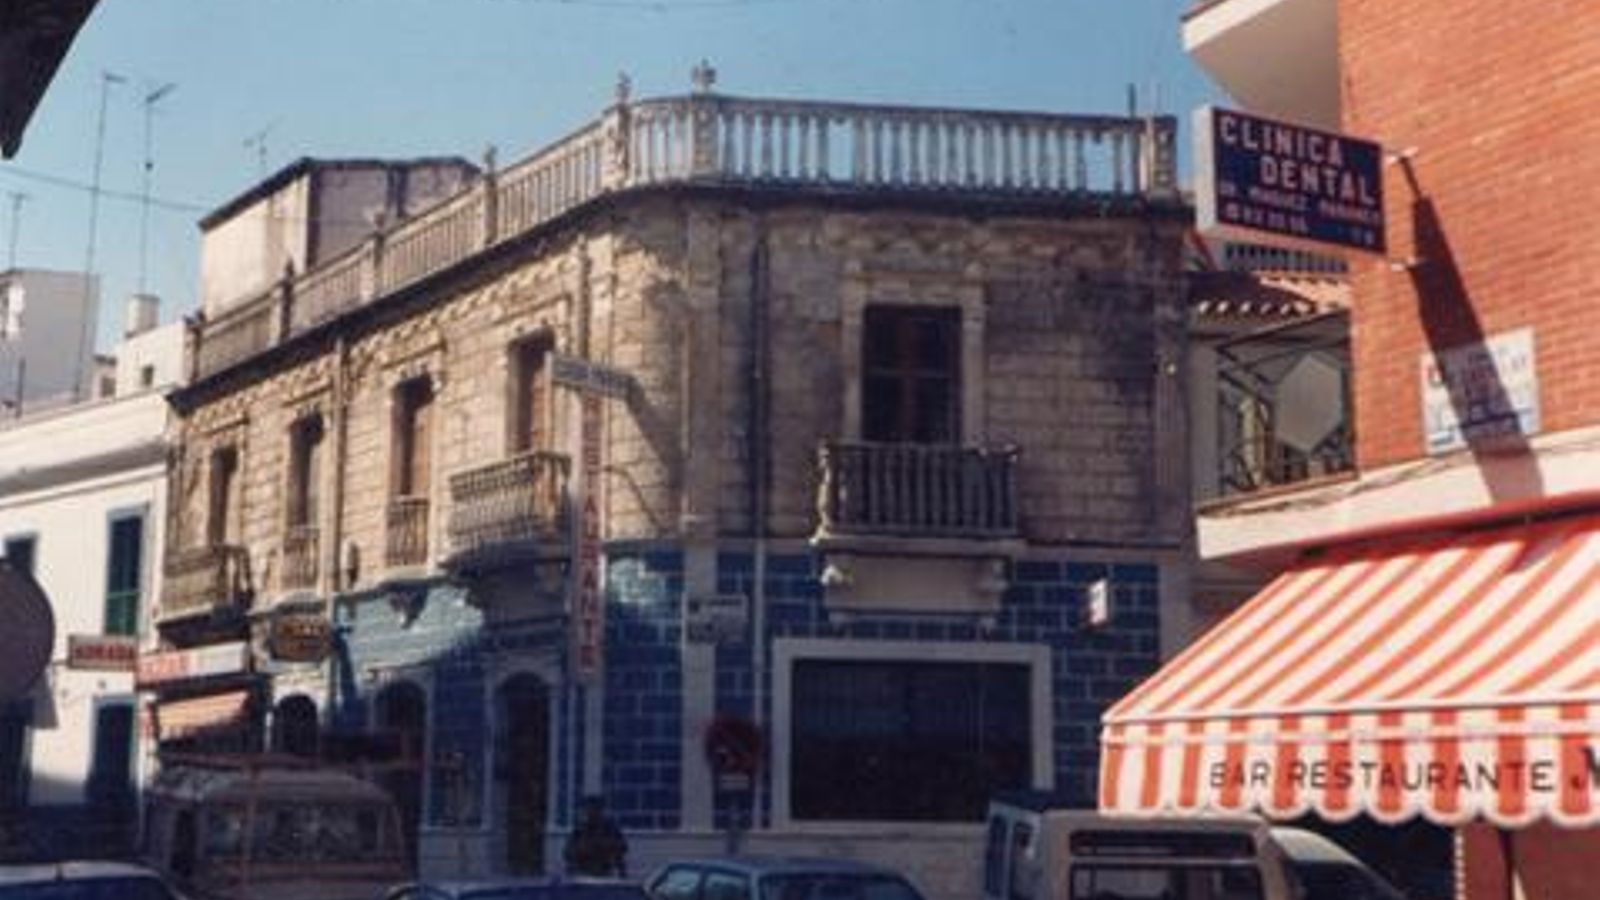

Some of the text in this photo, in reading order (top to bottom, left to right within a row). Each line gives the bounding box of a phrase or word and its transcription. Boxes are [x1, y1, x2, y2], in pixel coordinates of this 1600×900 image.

[1220, 114, 1343, 166] CLINICA
[1259, 155, 1376, 206] DENTAL
[1210, 761, 1271, 788] BAR
[1287, 760, 1554, 791] RESTAURANTE
